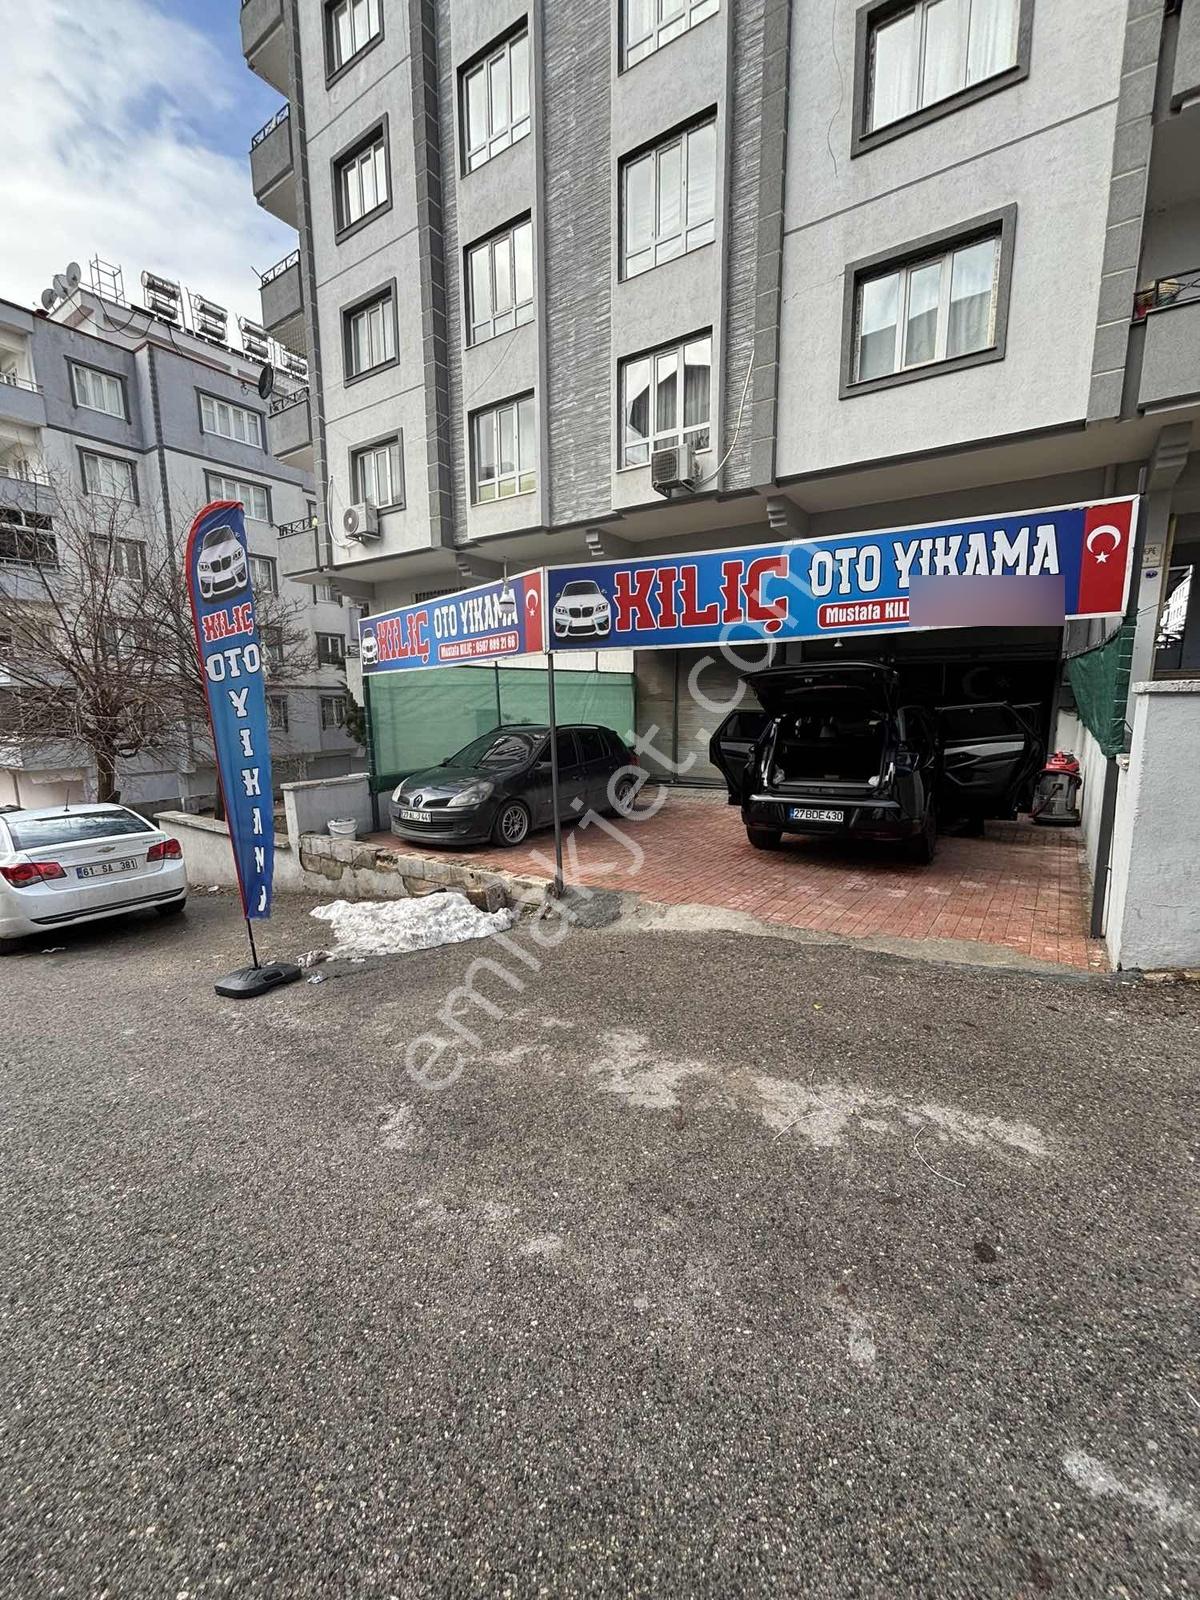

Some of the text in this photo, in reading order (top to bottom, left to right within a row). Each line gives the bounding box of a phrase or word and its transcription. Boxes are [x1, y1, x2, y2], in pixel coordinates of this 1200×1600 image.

[613, 524, 1060, 634] KILIÇ OTO YIKAMA
[202, 601, 254, 643] KILIÇ
[825, 600, 910, 624] Mustafa KILI
[376, 609, 430, 664] KILIÇ
[433, 604, 458, 639] OTO
[205, 643, 261, 682] OTO
[83, 860, 135, 876] 61 SA 381
